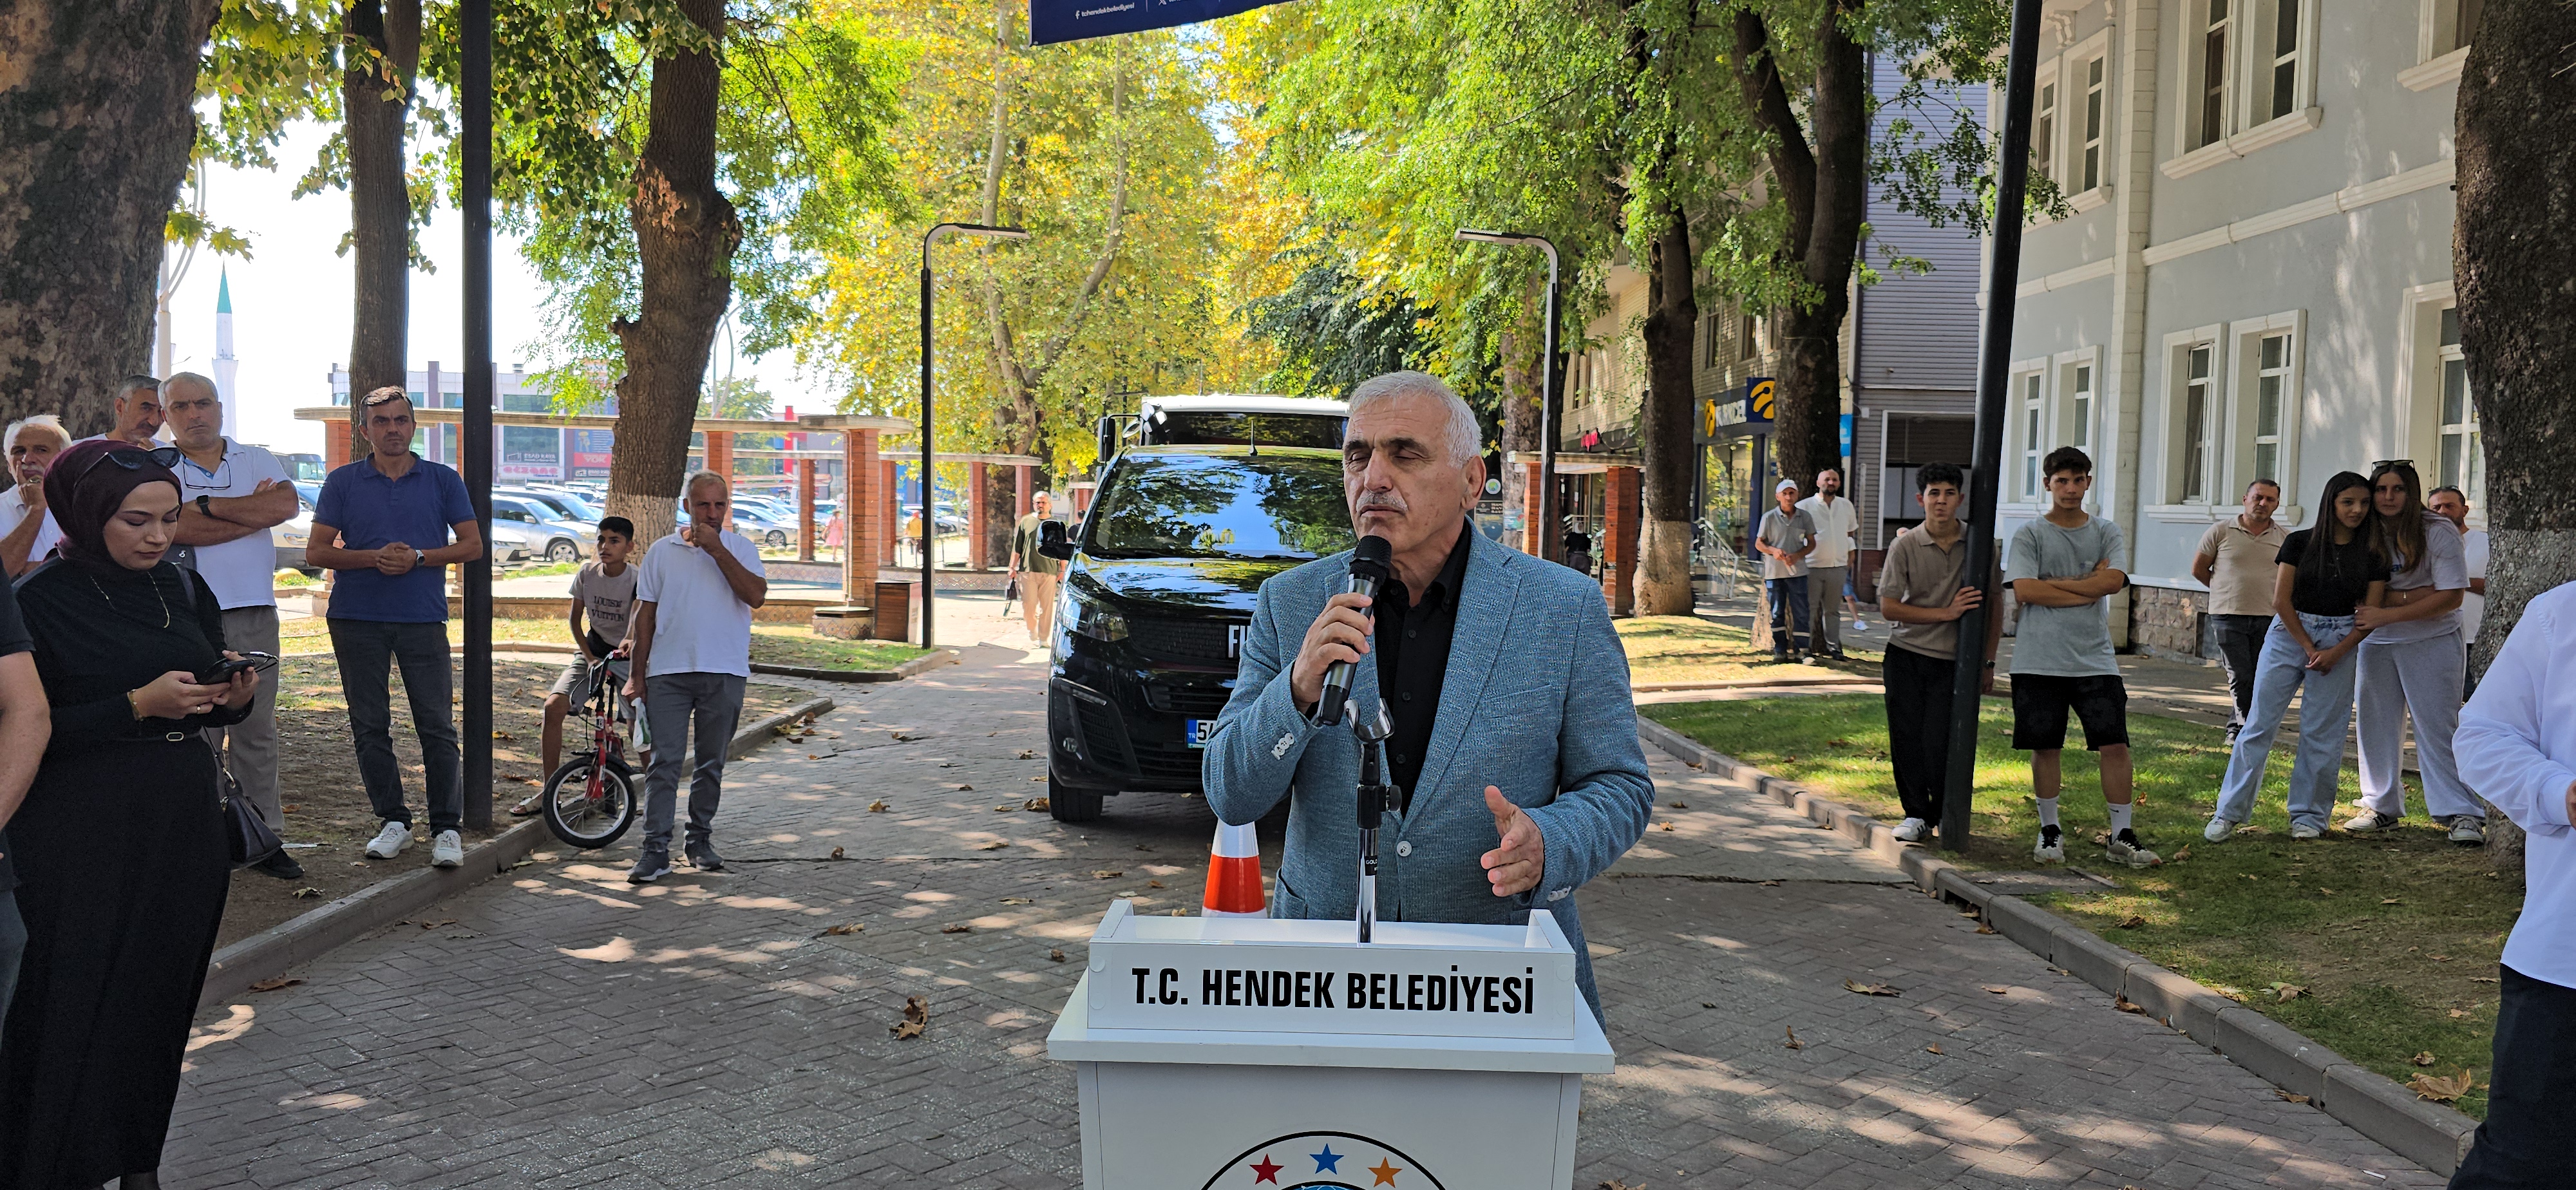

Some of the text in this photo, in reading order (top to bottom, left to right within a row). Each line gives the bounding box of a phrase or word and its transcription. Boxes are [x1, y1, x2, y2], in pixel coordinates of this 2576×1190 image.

[591, 609, 625, 621] VUITTON
[1228, 625, 1251, 658] FI
[1132, 965, 1533, 1014] T.C. HENDEK BELEDİYESİ
